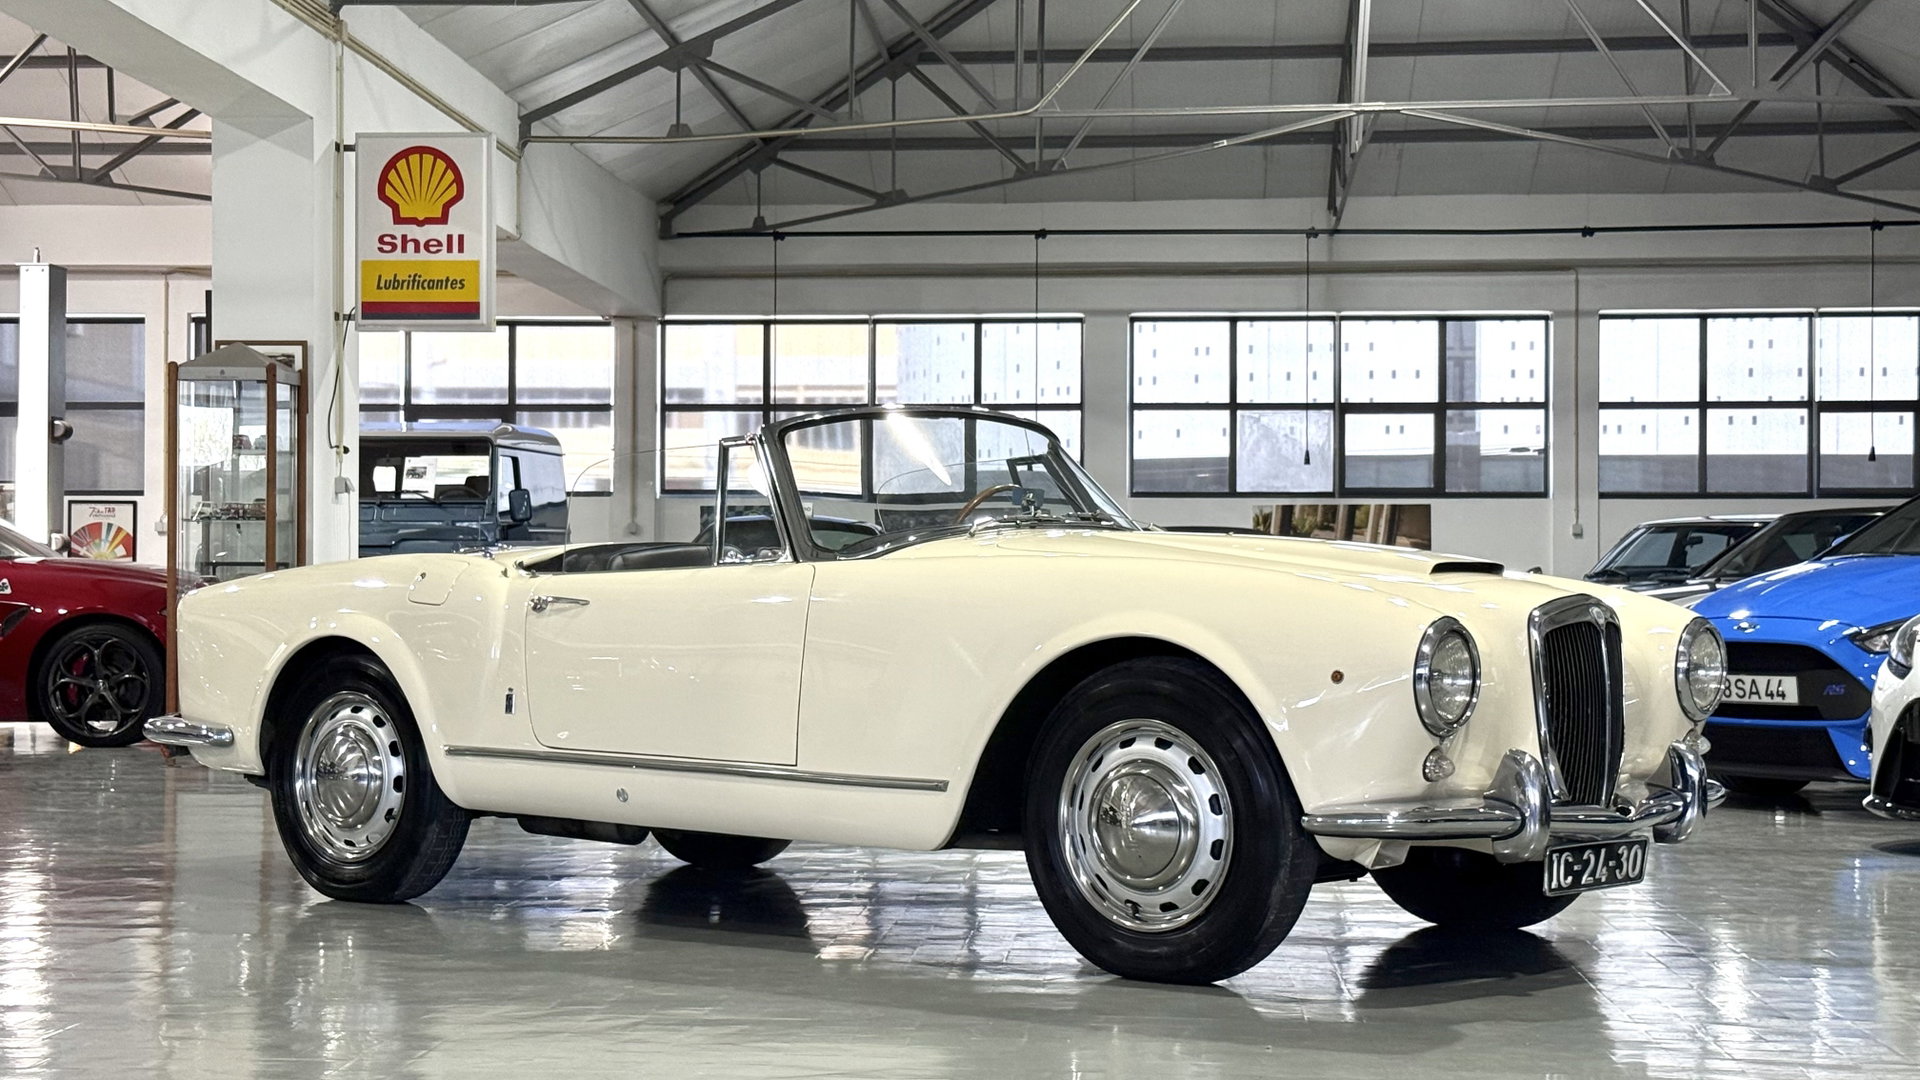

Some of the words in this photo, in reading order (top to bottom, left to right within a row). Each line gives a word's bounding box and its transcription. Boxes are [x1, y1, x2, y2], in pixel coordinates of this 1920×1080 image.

[377, 234, 465, 254] Shell
[376, 273, 466, 290] Lubrificantes
[1551, 844, 1643, 889] IC-24-30
